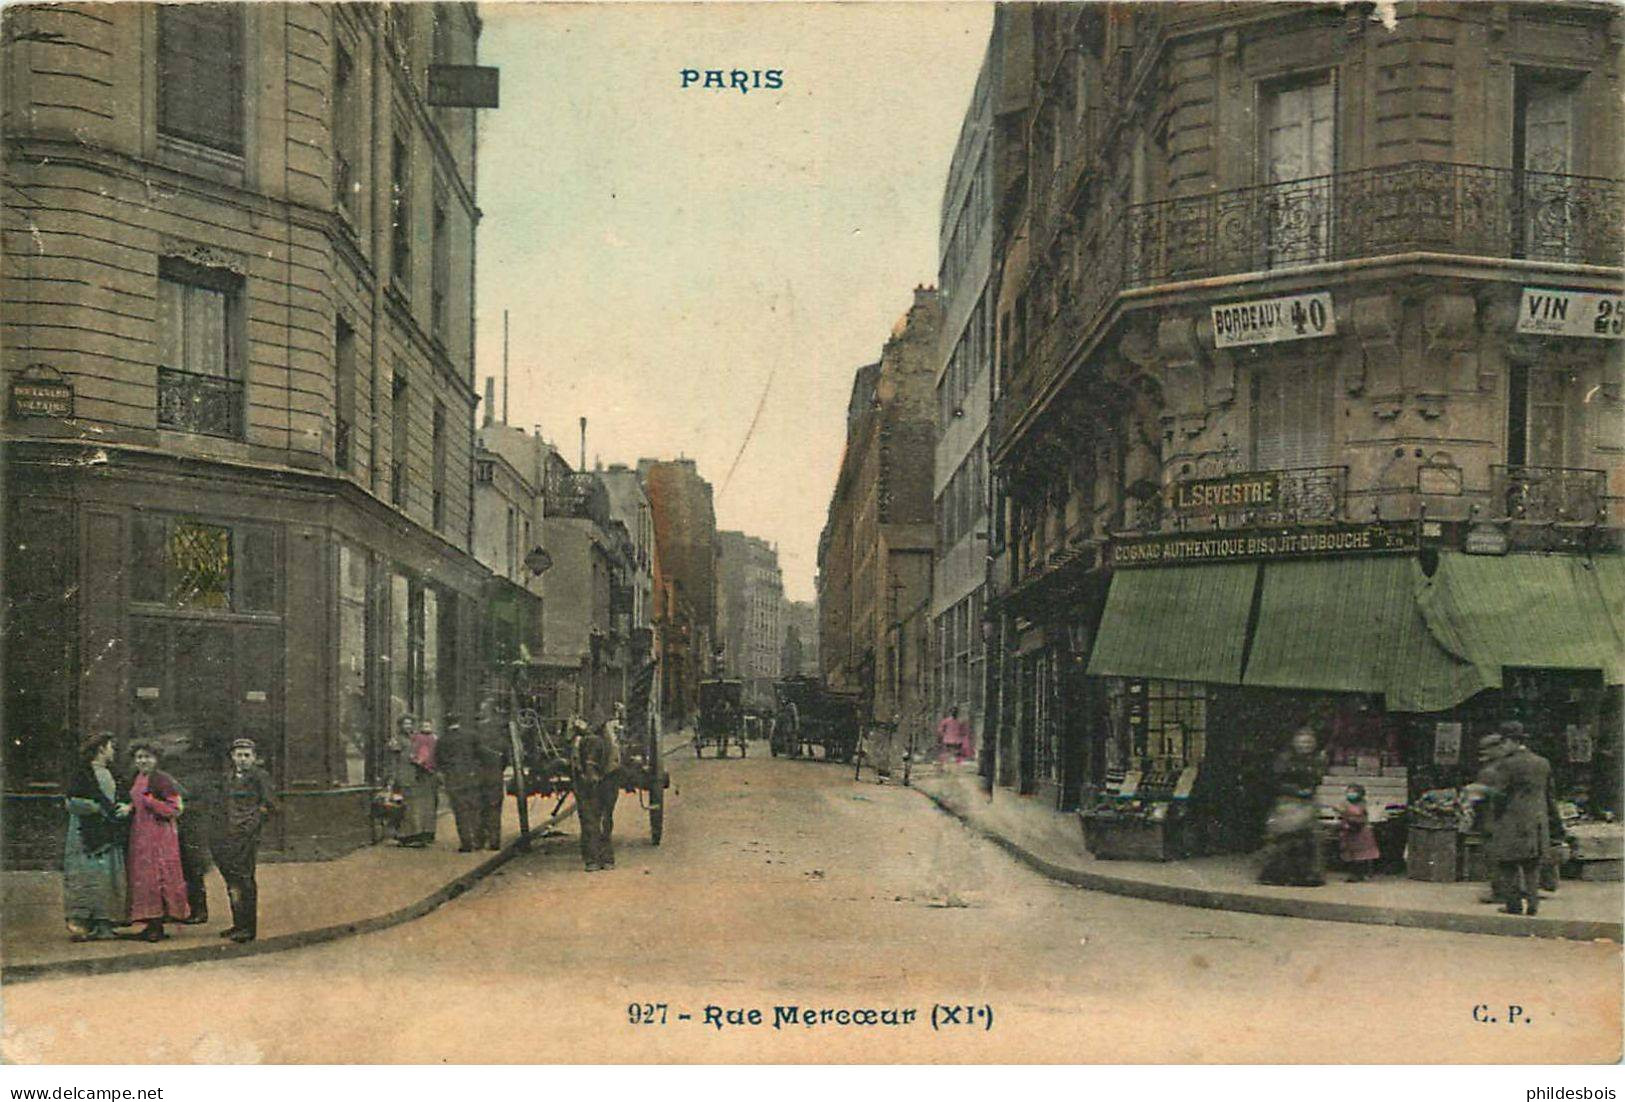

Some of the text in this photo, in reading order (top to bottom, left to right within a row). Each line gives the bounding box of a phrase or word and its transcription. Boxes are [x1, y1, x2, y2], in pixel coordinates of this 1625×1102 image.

[1215, 298, 1327, 335] BORDEAUX 40
[1529, 295, 1568, 320] VIN
[1163, 539, 1244, 560] AUTHENTIQUE
